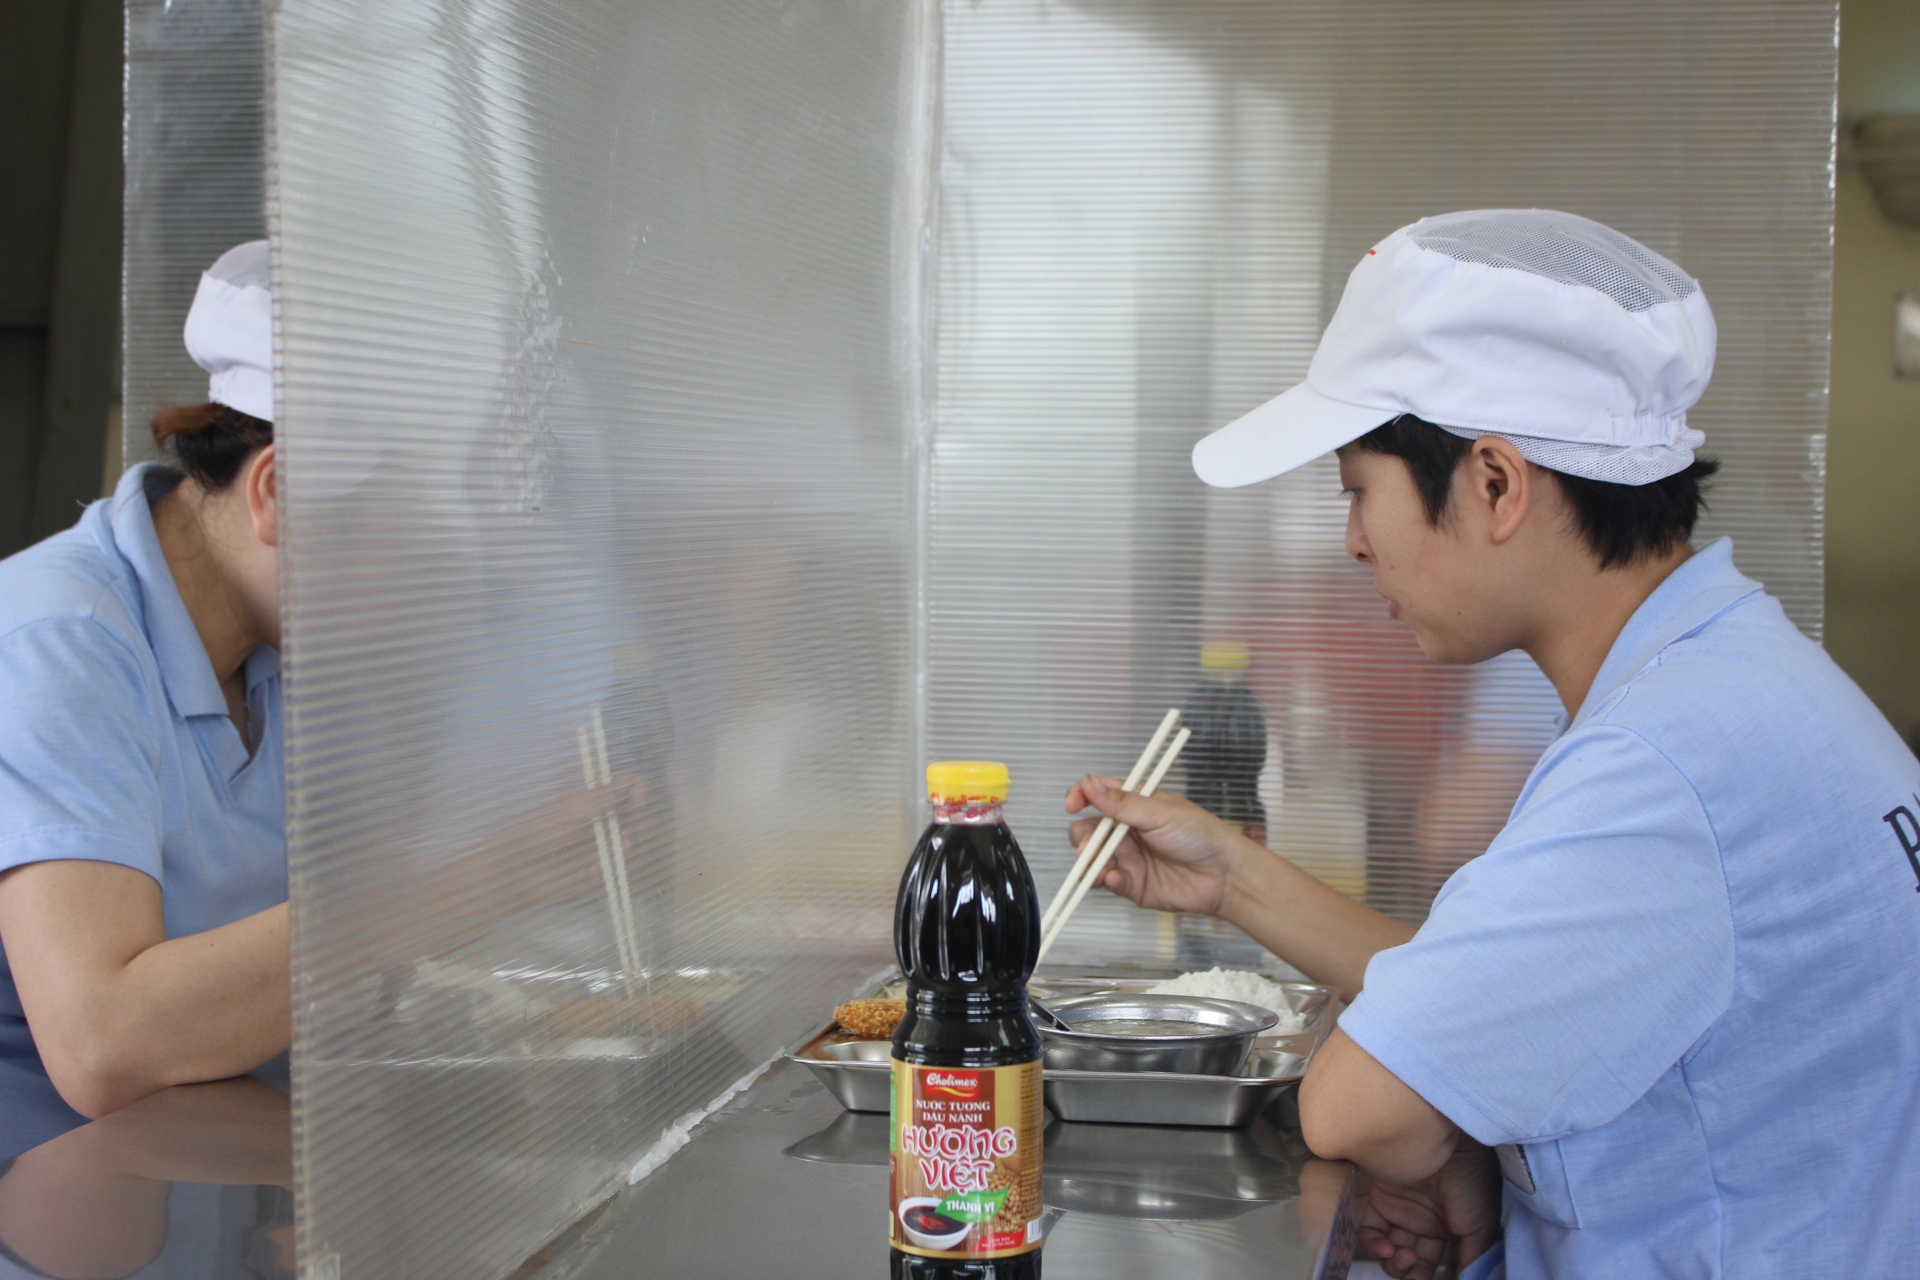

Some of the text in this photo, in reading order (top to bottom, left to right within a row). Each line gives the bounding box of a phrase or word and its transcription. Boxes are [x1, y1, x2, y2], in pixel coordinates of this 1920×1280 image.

[927, 1072, 978, 1087] Cholimex
[902, 1122, 1017, 1159] HƯƠNG
[919, 1154, 995, 1197] VIỆT
[946, 1200, 982, 1214] THANH
